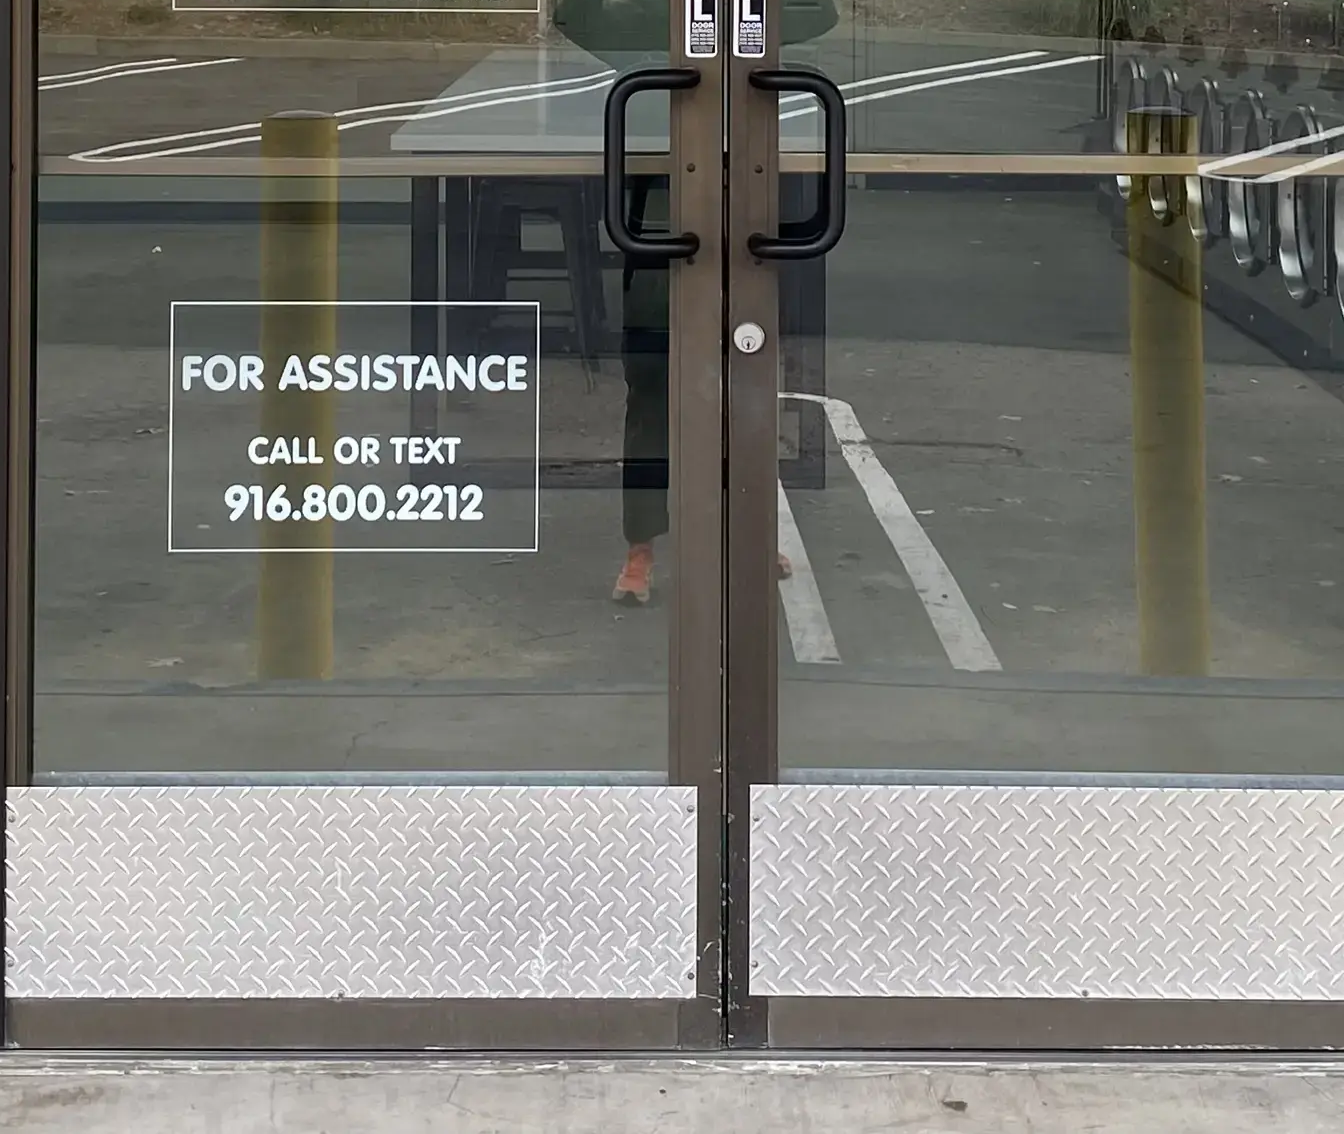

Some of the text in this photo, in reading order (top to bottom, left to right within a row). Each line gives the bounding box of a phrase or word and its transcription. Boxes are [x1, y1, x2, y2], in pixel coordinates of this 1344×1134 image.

[181, 354, 528, 392] FOR ASSISTANCE
[247, 436, 462, 465] CALL OR TEXT
[223, 484, 484, 522] 916.800.2212
